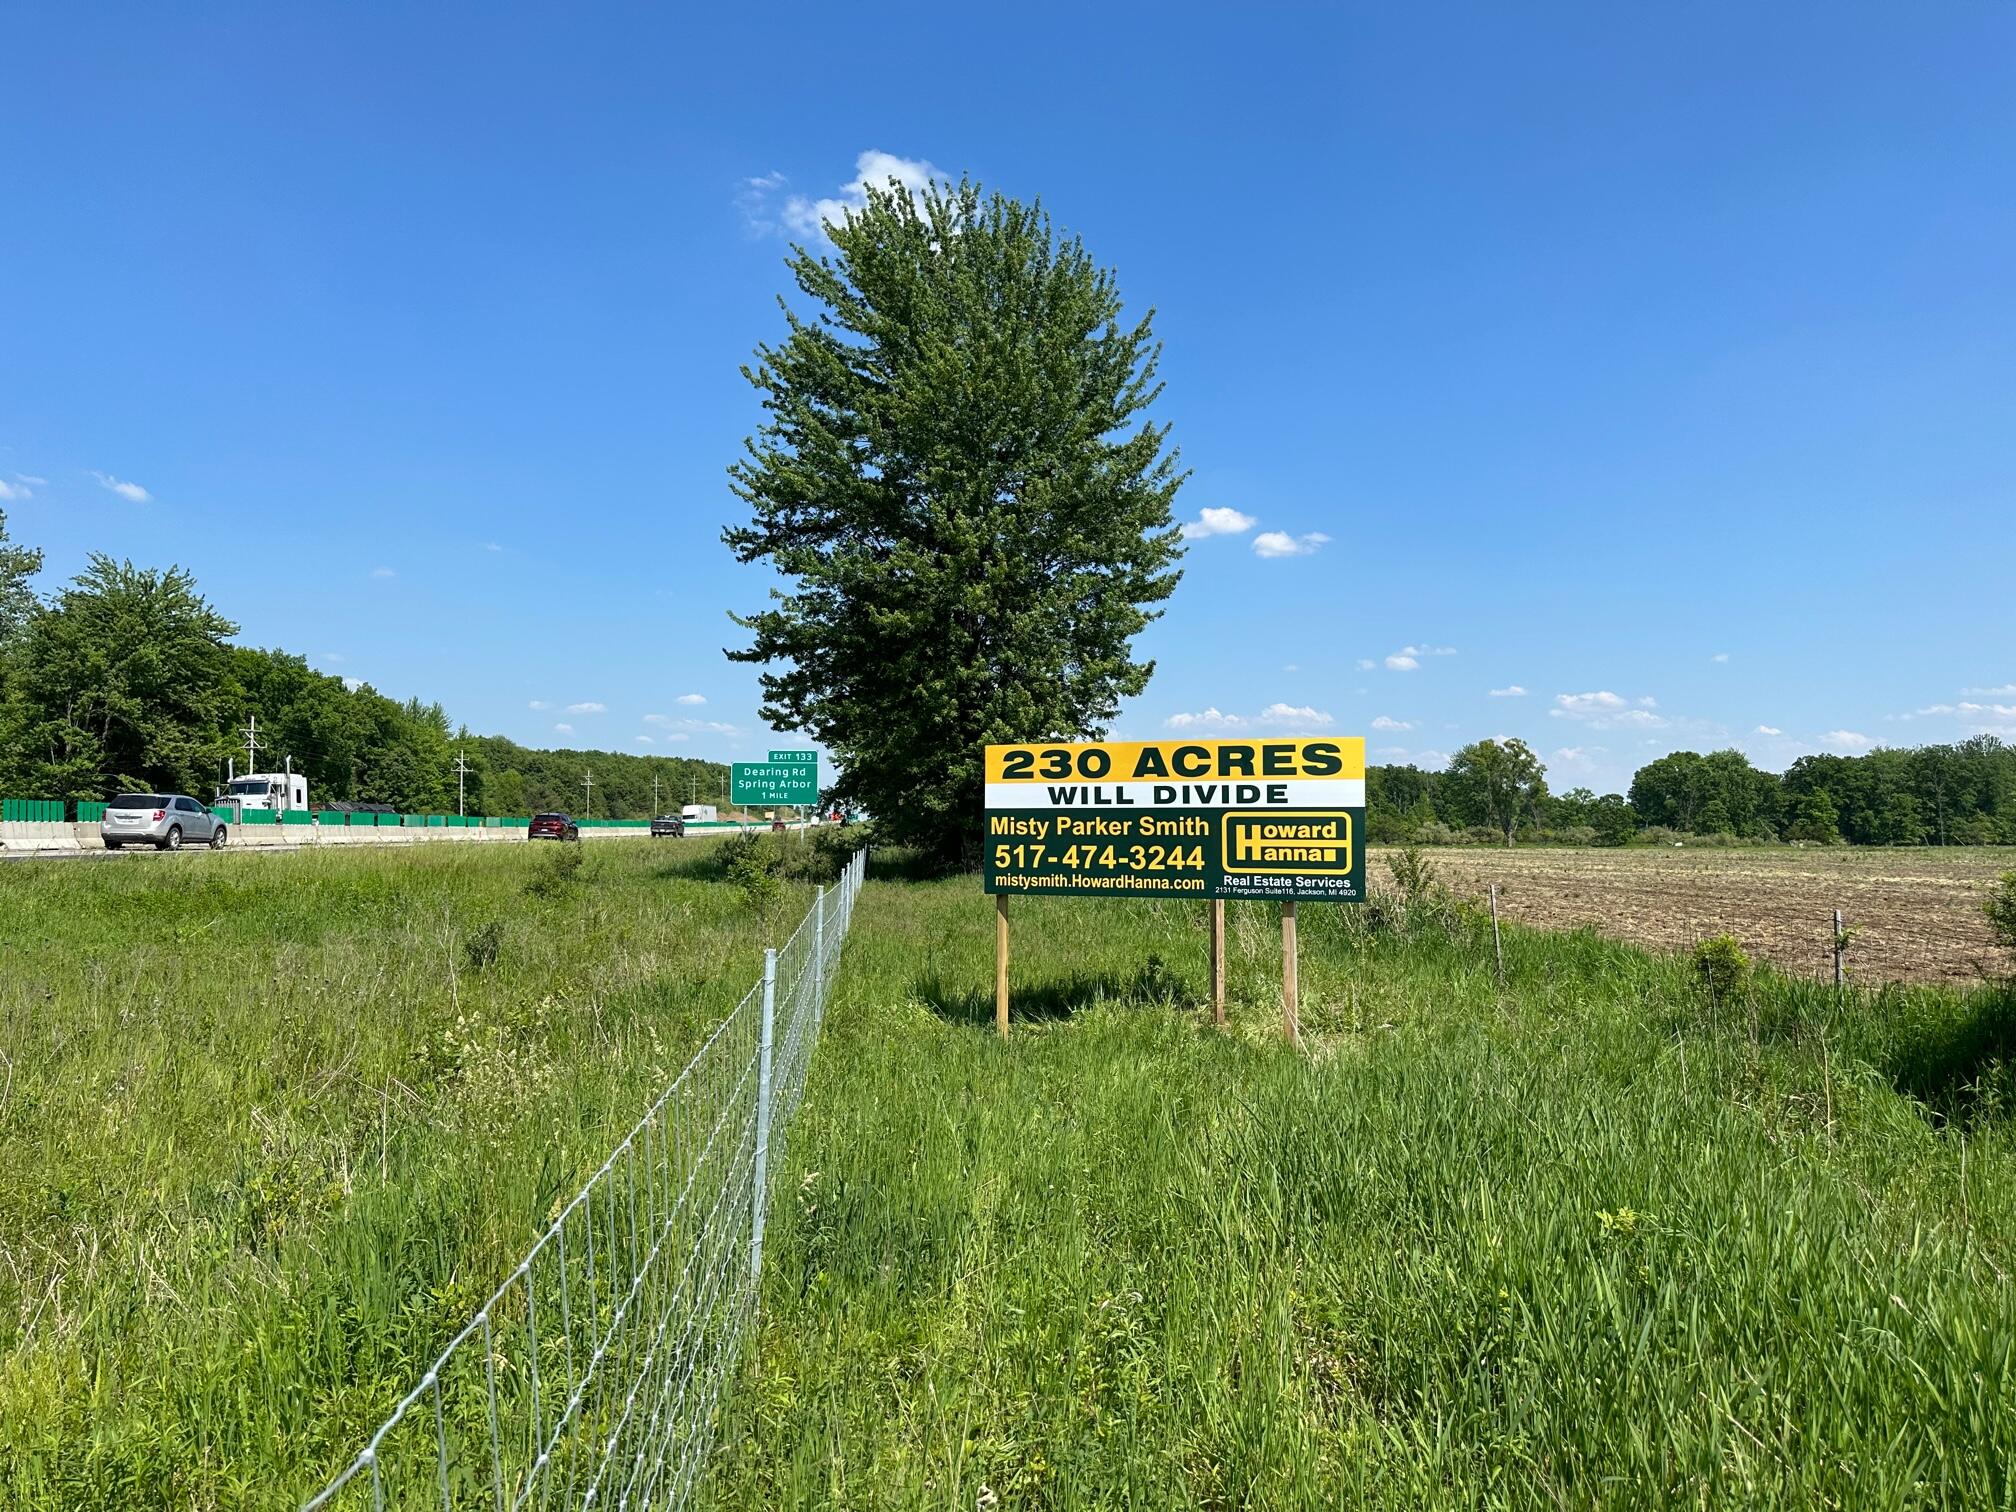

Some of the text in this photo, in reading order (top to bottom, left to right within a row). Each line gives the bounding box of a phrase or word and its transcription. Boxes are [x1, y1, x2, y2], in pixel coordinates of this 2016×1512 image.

[1002, 743, 1343, 779] 230 ACRES
[744, 767, 806, 778] Dearing Rd
[738, 779, 812, 790] Spring Arbor
[1047, 784, 1289, 805] WILL DIVIDE
[990, 816, 1210, 840] Misty Parker Smith
[1236, 822, 1337, 842] Howard
[994, 844, 1205, 871] 517-474-3244
[994, 873, 1205, 891] mistysmith.HowardHanna.com
[1223, 875, 1351, 888] Real Estate Services
[1233, 887, 1264, 895] Ferguson
[1297, 888, 1327, 896] Jackson,
